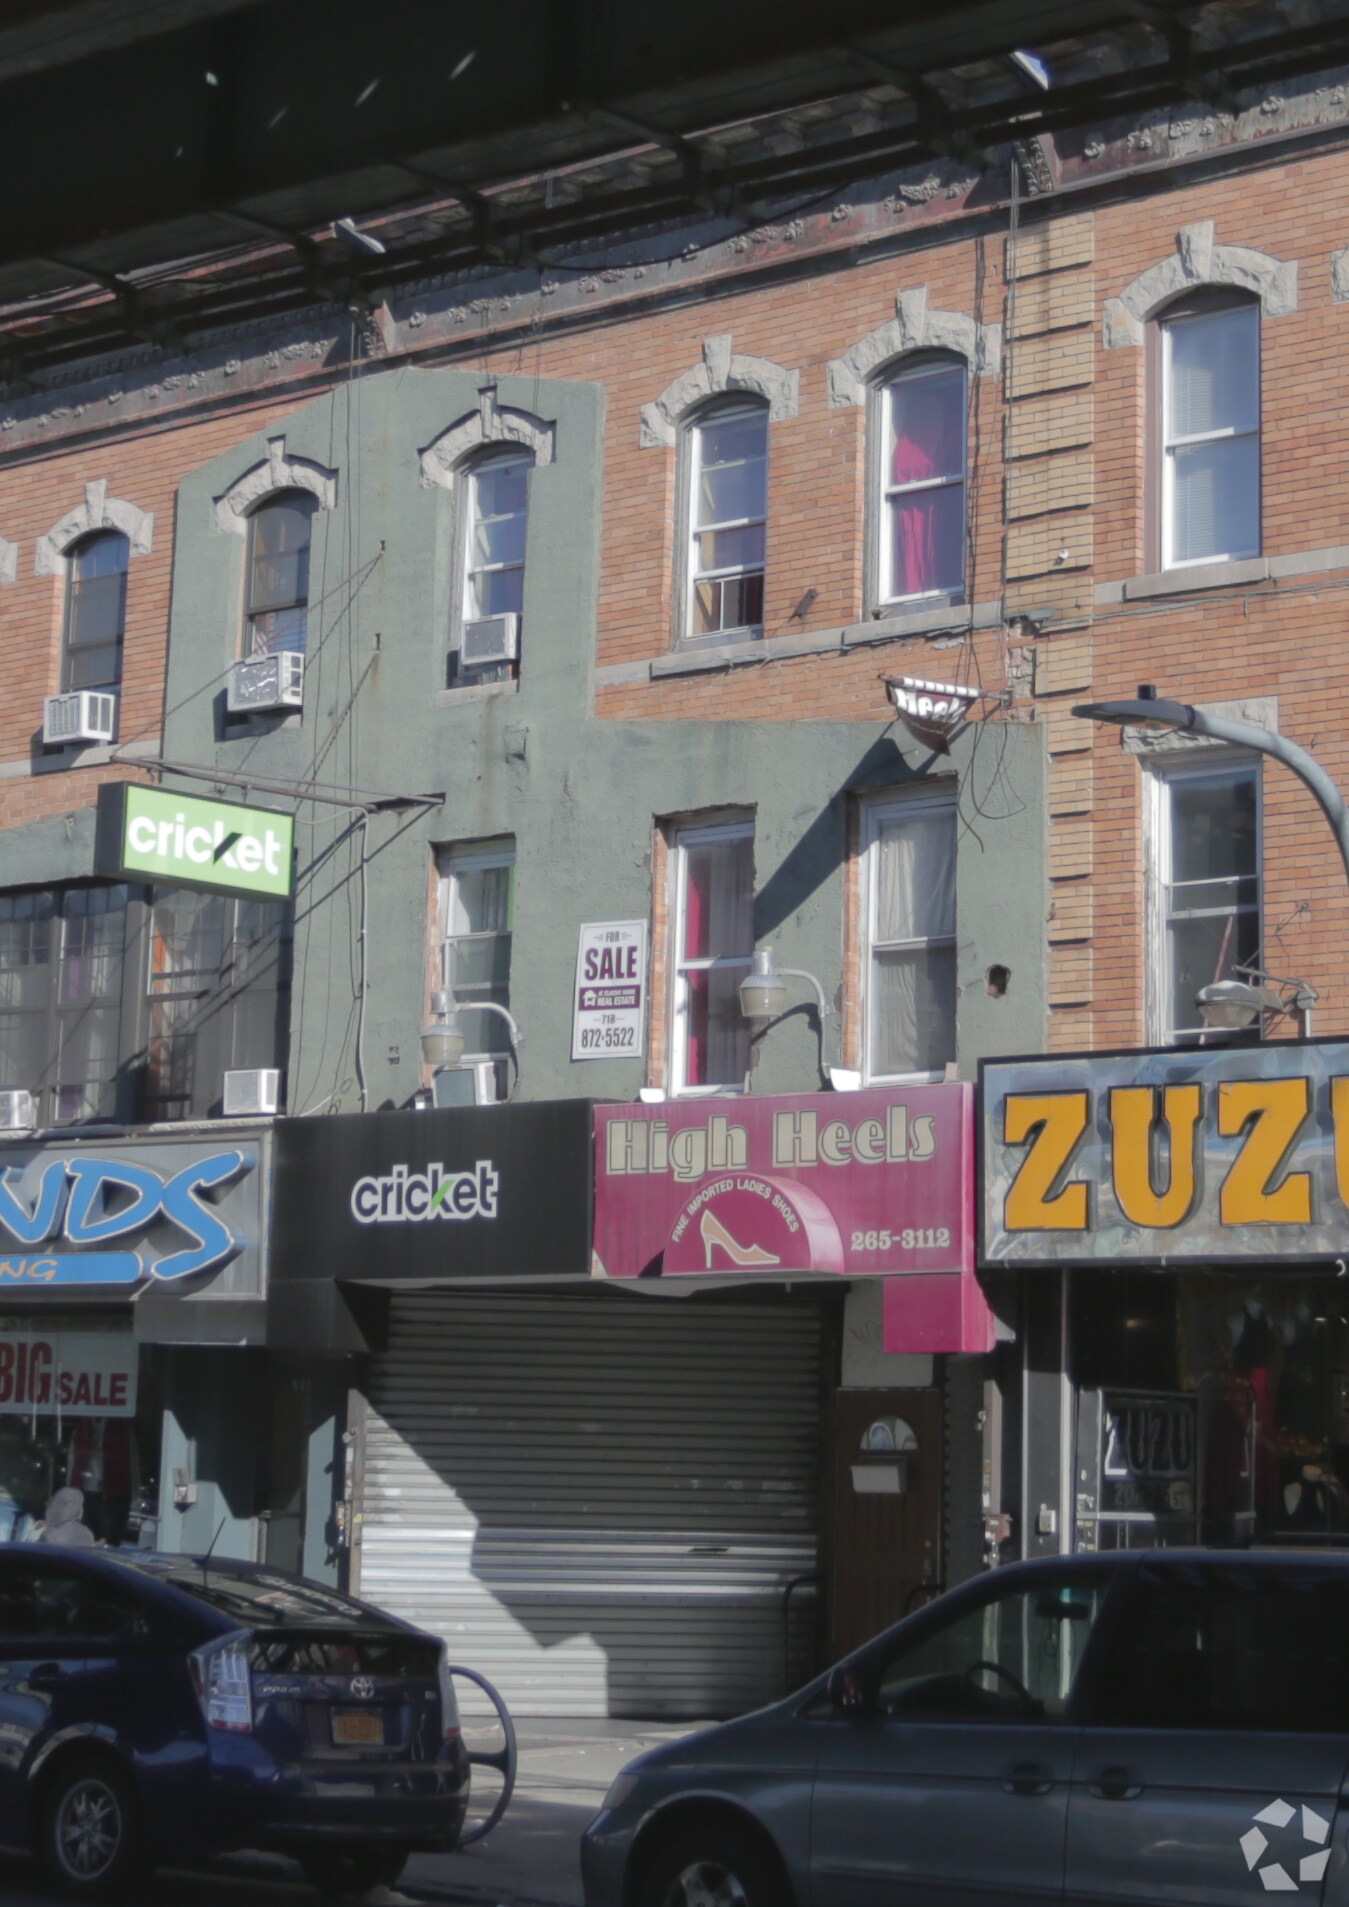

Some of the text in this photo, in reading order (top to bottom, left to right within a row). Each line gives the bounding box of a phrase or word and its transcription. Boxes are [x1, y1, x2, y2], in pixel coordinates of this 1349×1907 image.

[127, 812, 281, 876] cricket
[584, 946, 638, 981] SALE
[605, 931, 620, 943] FOR
[597, 995, 636, 1006] REAL ESTATE
[601, 1014, 616, 1024] 718
[605, 1104, 937, 1183] High Heels
[1003, 1075, 1349, 1232] ZUZ
[350, 1160, 499, 1224] cricket
[671, 1178, 800, 1243] FINE IMPORTED LADIES SHOES
[850, 1228, 950, 1251] 265-3112
[0, 1341, 129, 1407] BIG SALE
